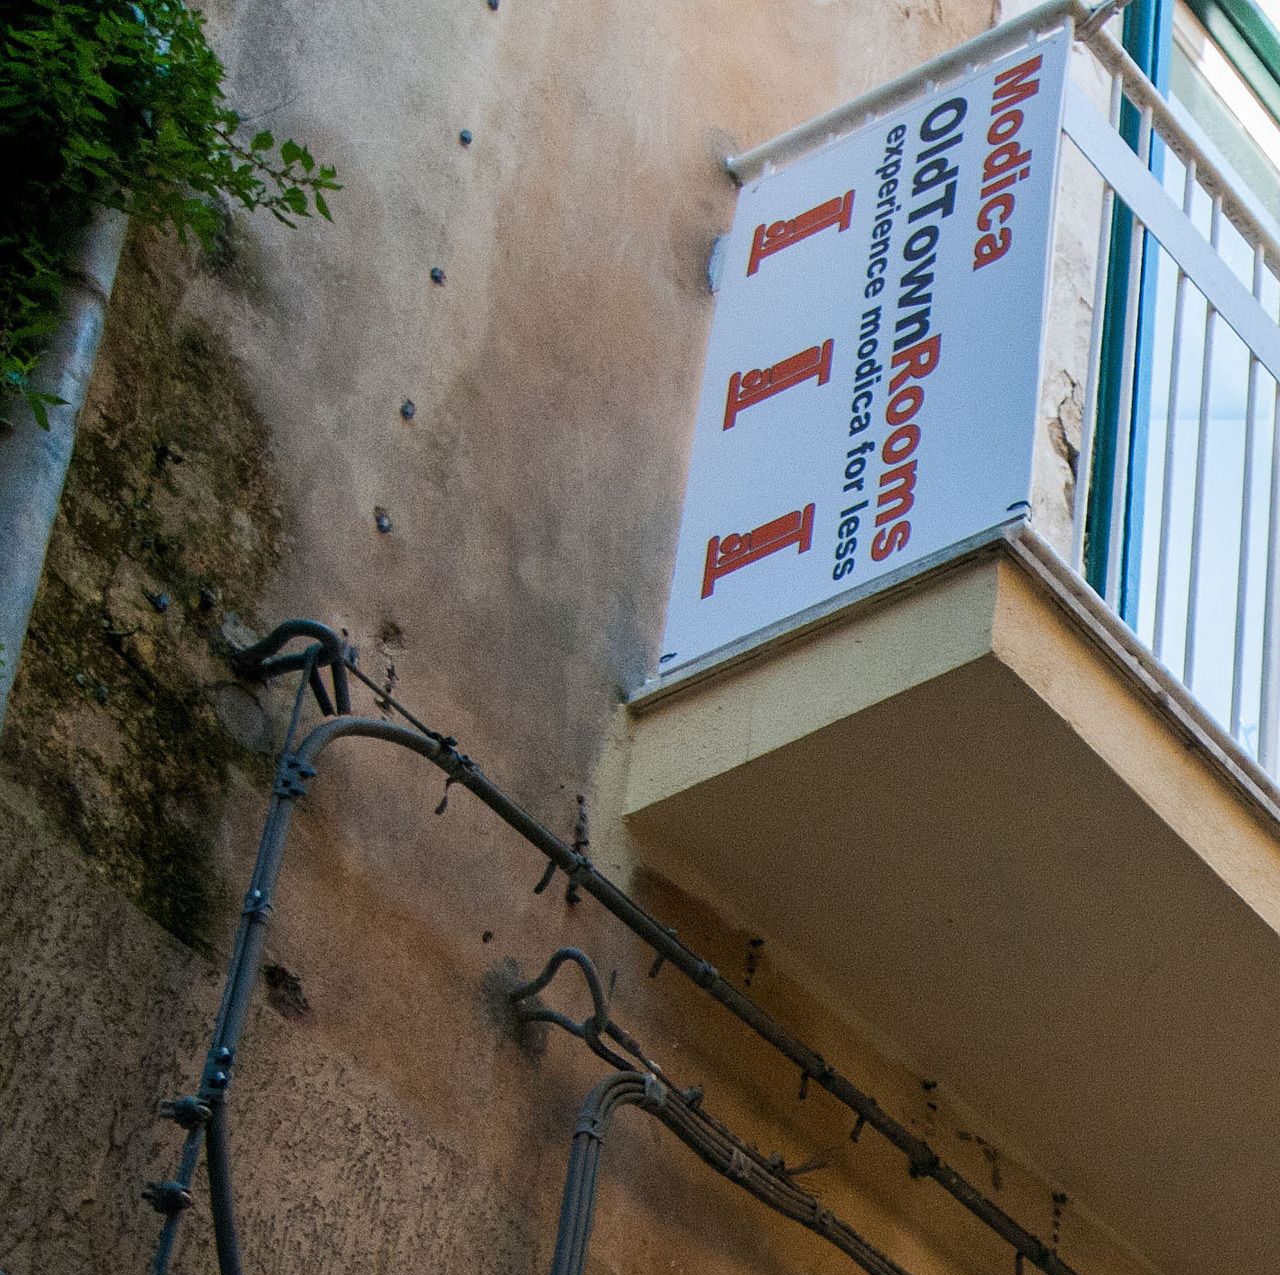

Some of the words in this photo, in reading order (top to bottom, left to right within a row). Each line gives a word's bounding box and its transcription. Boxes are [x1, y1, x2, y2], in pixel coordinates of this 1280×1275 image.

[863, 123, 908, 299] experience
[973, 53, 1044, 271] Modica
[849, 306, 885, 437] modica
[871, 97, 968, 562] OldTownRooms
[832, 500, 869, 581] less
[843, 440, 875, 492] for
